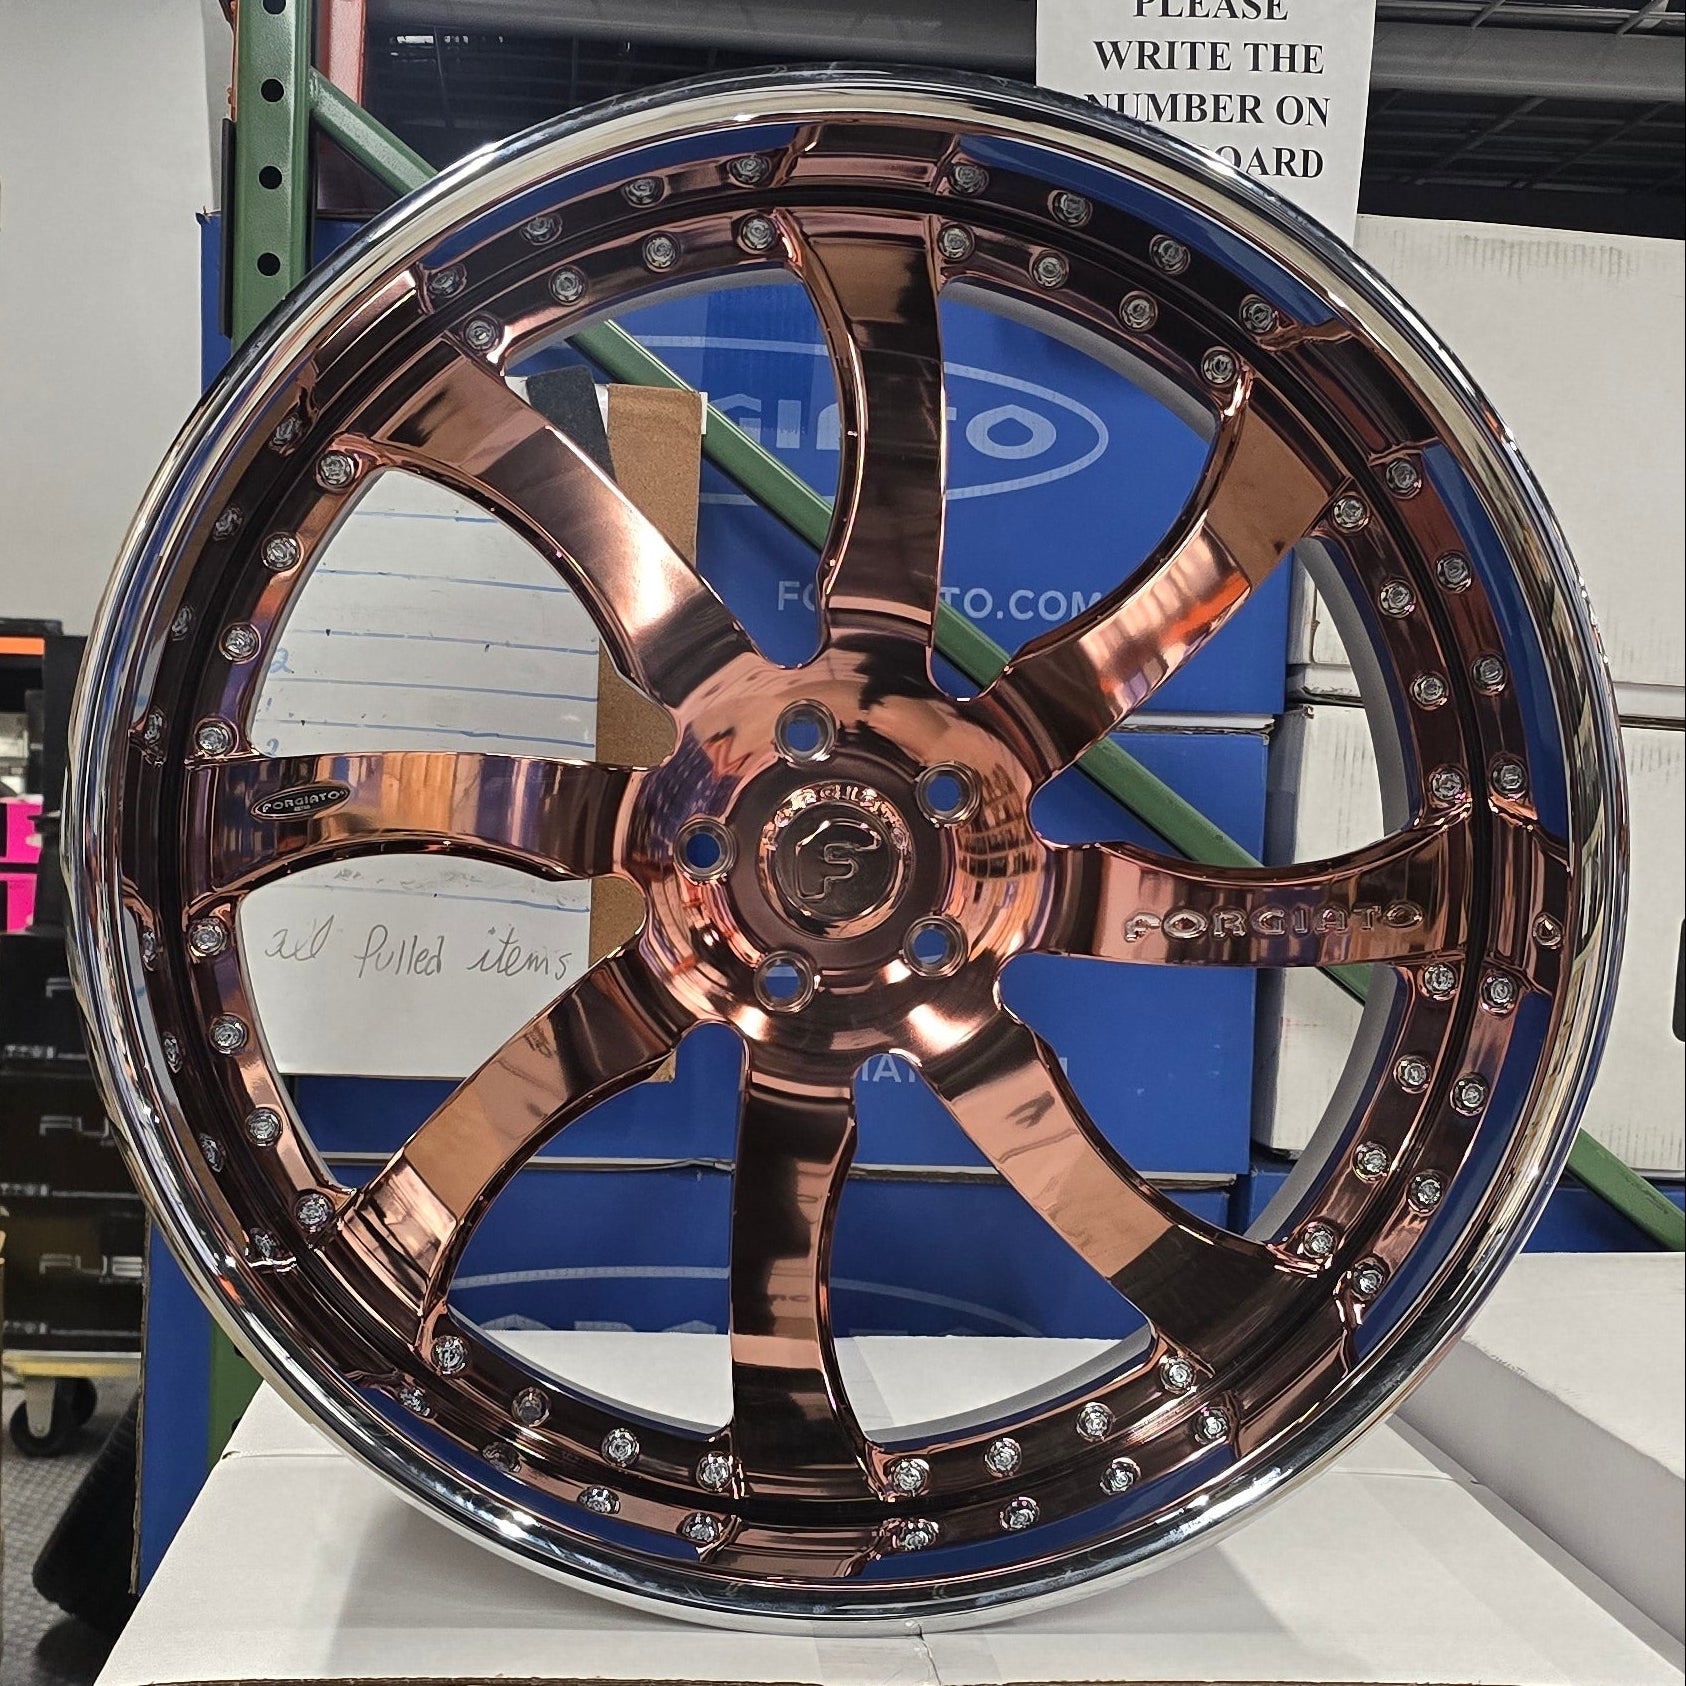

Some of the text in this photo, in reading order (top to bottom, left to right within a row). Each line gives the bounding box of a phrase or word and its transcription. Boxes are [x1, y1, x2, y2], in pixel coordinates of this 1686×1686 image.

[1133, 0, 1288, 21] PLEASE
[1093, 41, 1324, 75] WRITE THE
[1276, 95, 1331, 128] ON
[1200, 145, 1324, 178] OARD
[262, 790, 340, 813] FORGIATO
[1124, 902, 1425, 942] FORGIATO
[467, 926, 572, 980] items
